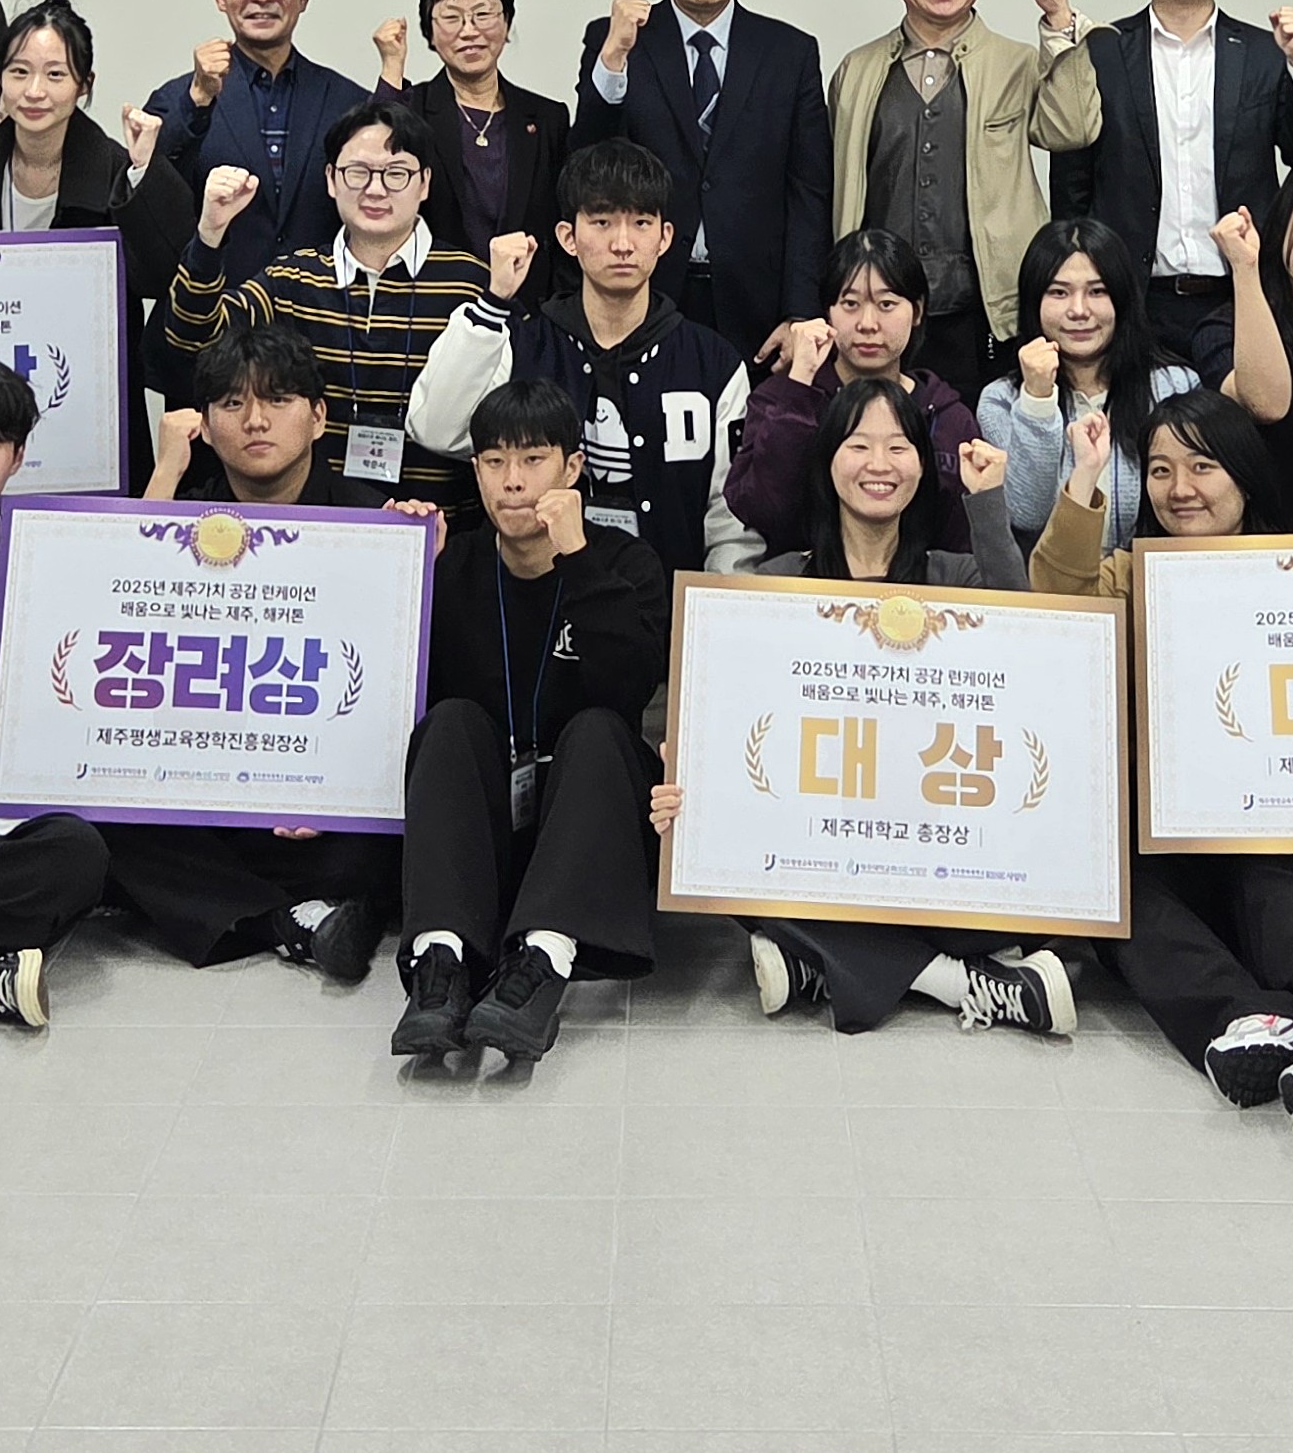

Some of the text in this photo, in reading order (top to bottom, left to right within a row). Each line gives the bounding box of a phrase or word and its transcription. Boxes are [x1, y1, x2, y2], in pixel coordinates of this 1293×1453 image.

[661, 391, 711, 462] D
[112, 579, 316, 602] 2025년 제주가치 공감 런케이션
[121, 602, 304, 623] 배움으로 빛나는 제주, 해커톤
[94, 631, 328, 715] 장려상
[792, 661, 1005, 689] 2025년 제주가치 공감 런케이션
[802, 685, 994, 711] 배움으로 빛나는 제주, 해커톤
[97, 728, 308, 753] 제주평생교육장학진흥원장상
[822, 819, 969, 845] 제주대학교 총장상
